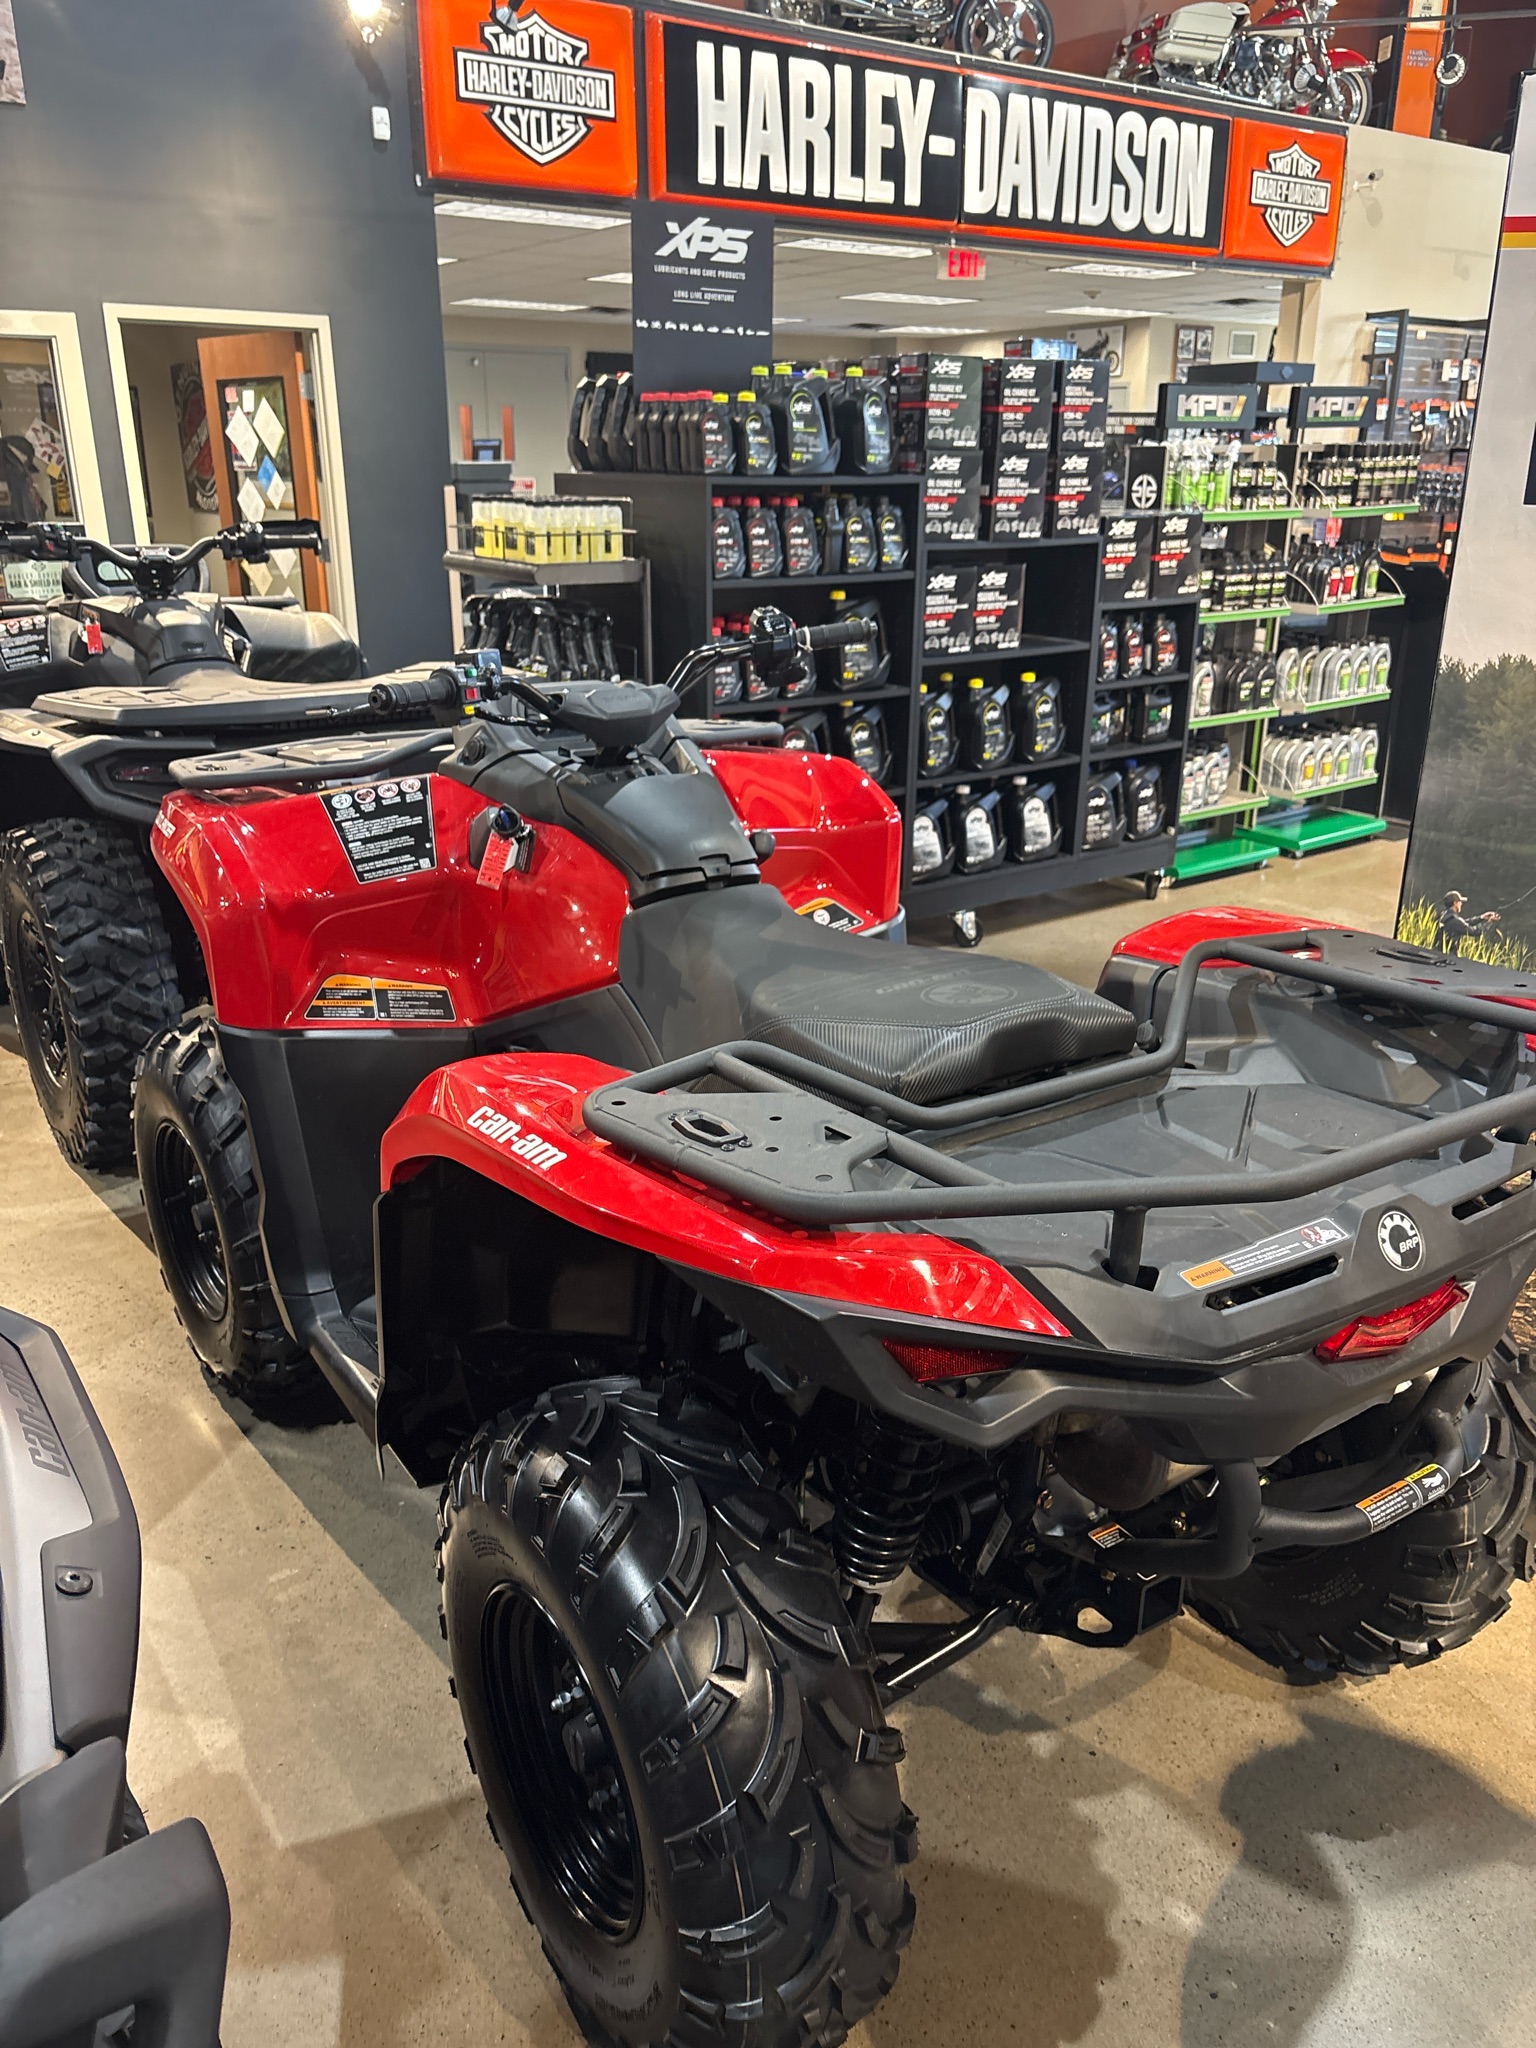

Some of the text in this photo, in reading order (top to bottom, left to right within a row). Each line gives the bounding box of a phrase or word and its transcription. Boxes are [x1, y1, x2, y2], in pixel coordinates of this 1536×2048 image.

[500, 23, 575, 66] MOTOR
[465, 59, 608, 110] HARLEY-DAVIDSON
[503, 105, 577, 152] CYCLES
[696, 40, 1214, 238] HARLEY-DAVIDSON
[1275, 150, 1313, 178] MOTOR
[1256, 177, 1327, 208] HARLEY-DAVIDSON
[1271, 208, 1309, 239] CYCLES
[654, 216, 754, 264] XPS
[653, 264, 746, 281] LUBRICANTS AND CARE PRODUCTS
[948, 249, 979, 278] EXIT
[931, 358, 963, 375] XPS
[1005, 363, 1037, 380] XPS
[1066, 363, 1095, 380] XPS
[466, 1105, 568, 1172] can-am
[1399, 1235, 1419, 1253] BRP
[1195, 1266, 1226, 1280] WARNING
